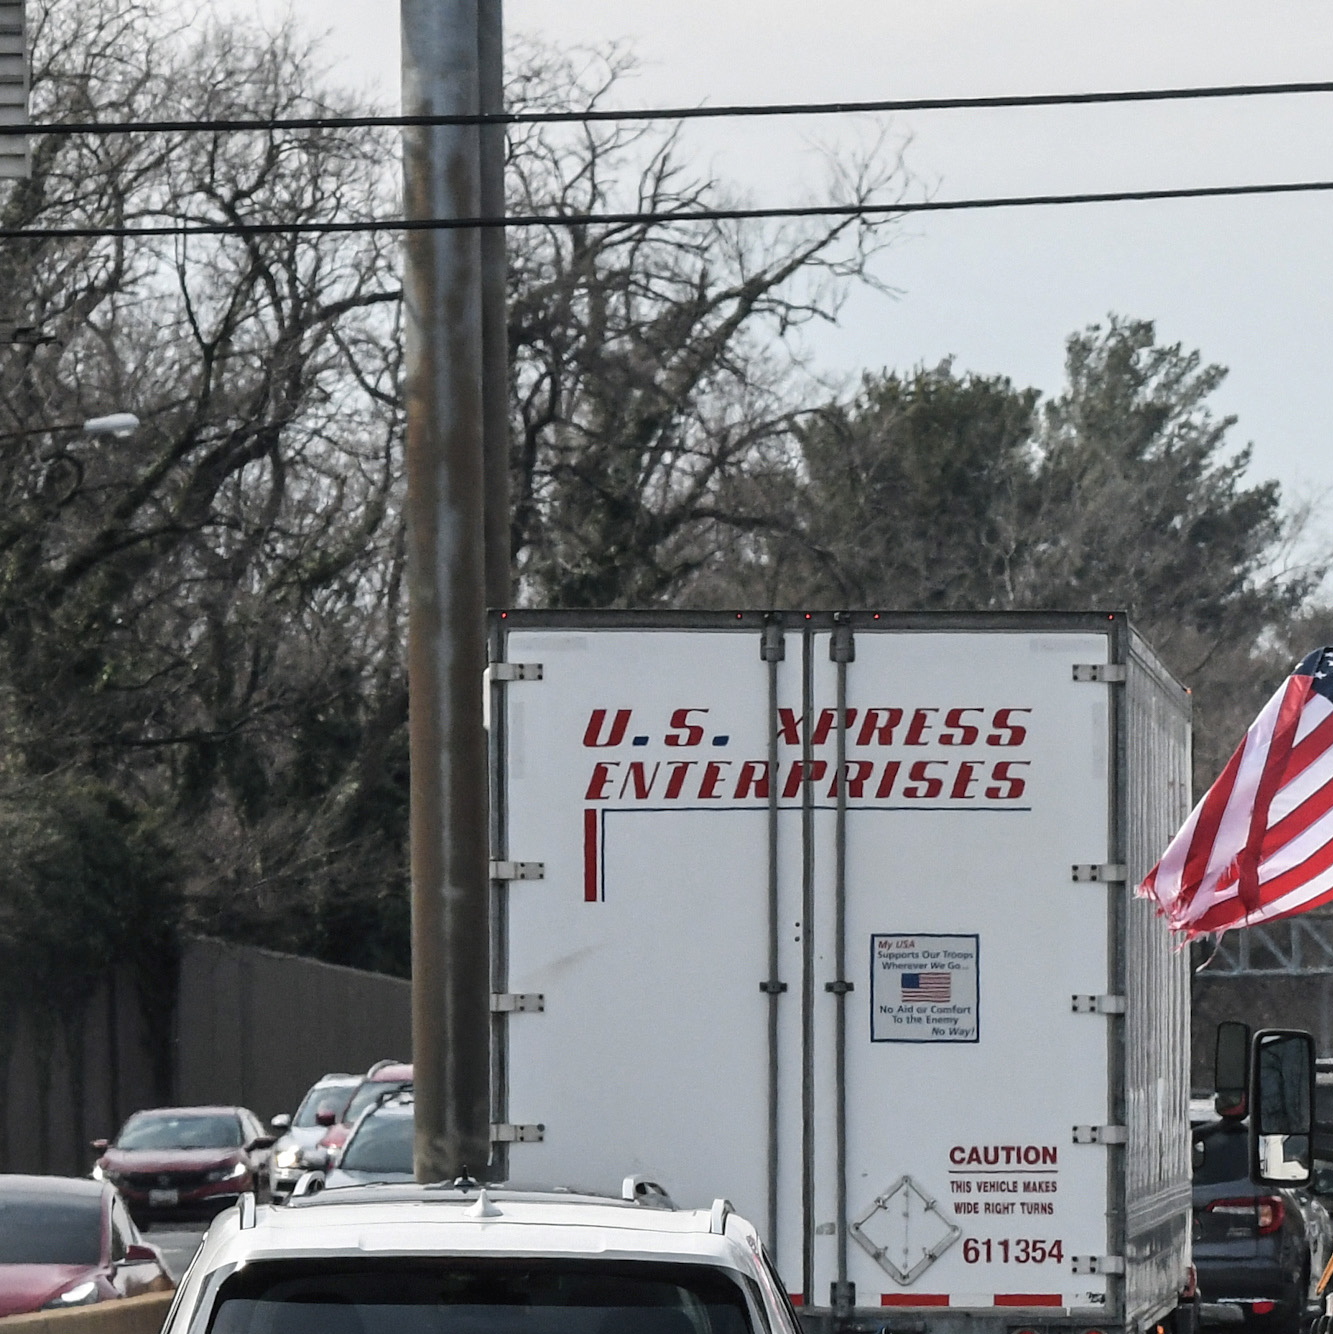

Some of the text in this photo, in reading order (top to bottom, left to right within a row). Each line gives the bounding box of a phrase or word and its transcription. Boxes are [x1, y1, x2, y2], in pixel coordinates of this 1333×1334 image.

[583, 708, 1032, 747] U.S. XPRESS
[584, 760, 1032, 800] ENTERPRISES
[878, 940, 915, 950] My USA
[877, 950, 974, 960] Supports Our Troops
[882, 962, 928, 970] Wherever
[930, 962, 945, 970] We
[880, 1005, 894, 1014] No
[897, 1005, 914, 1014] Aid
[930, 1005, 971, 1014] Comfort
[892, 1015, 960, 1025] To the Enemy
[931, 1027, 946, 1036] No
[949, 1145, 1058, 1165] CAUTION
[950, 1180, 1058, 1193] THIS VEHICLE MAKES
[954, 1202, 1054, 1215] WIDE RIGHT TURNS
[963, 1238, 1064, 1265] 611354
